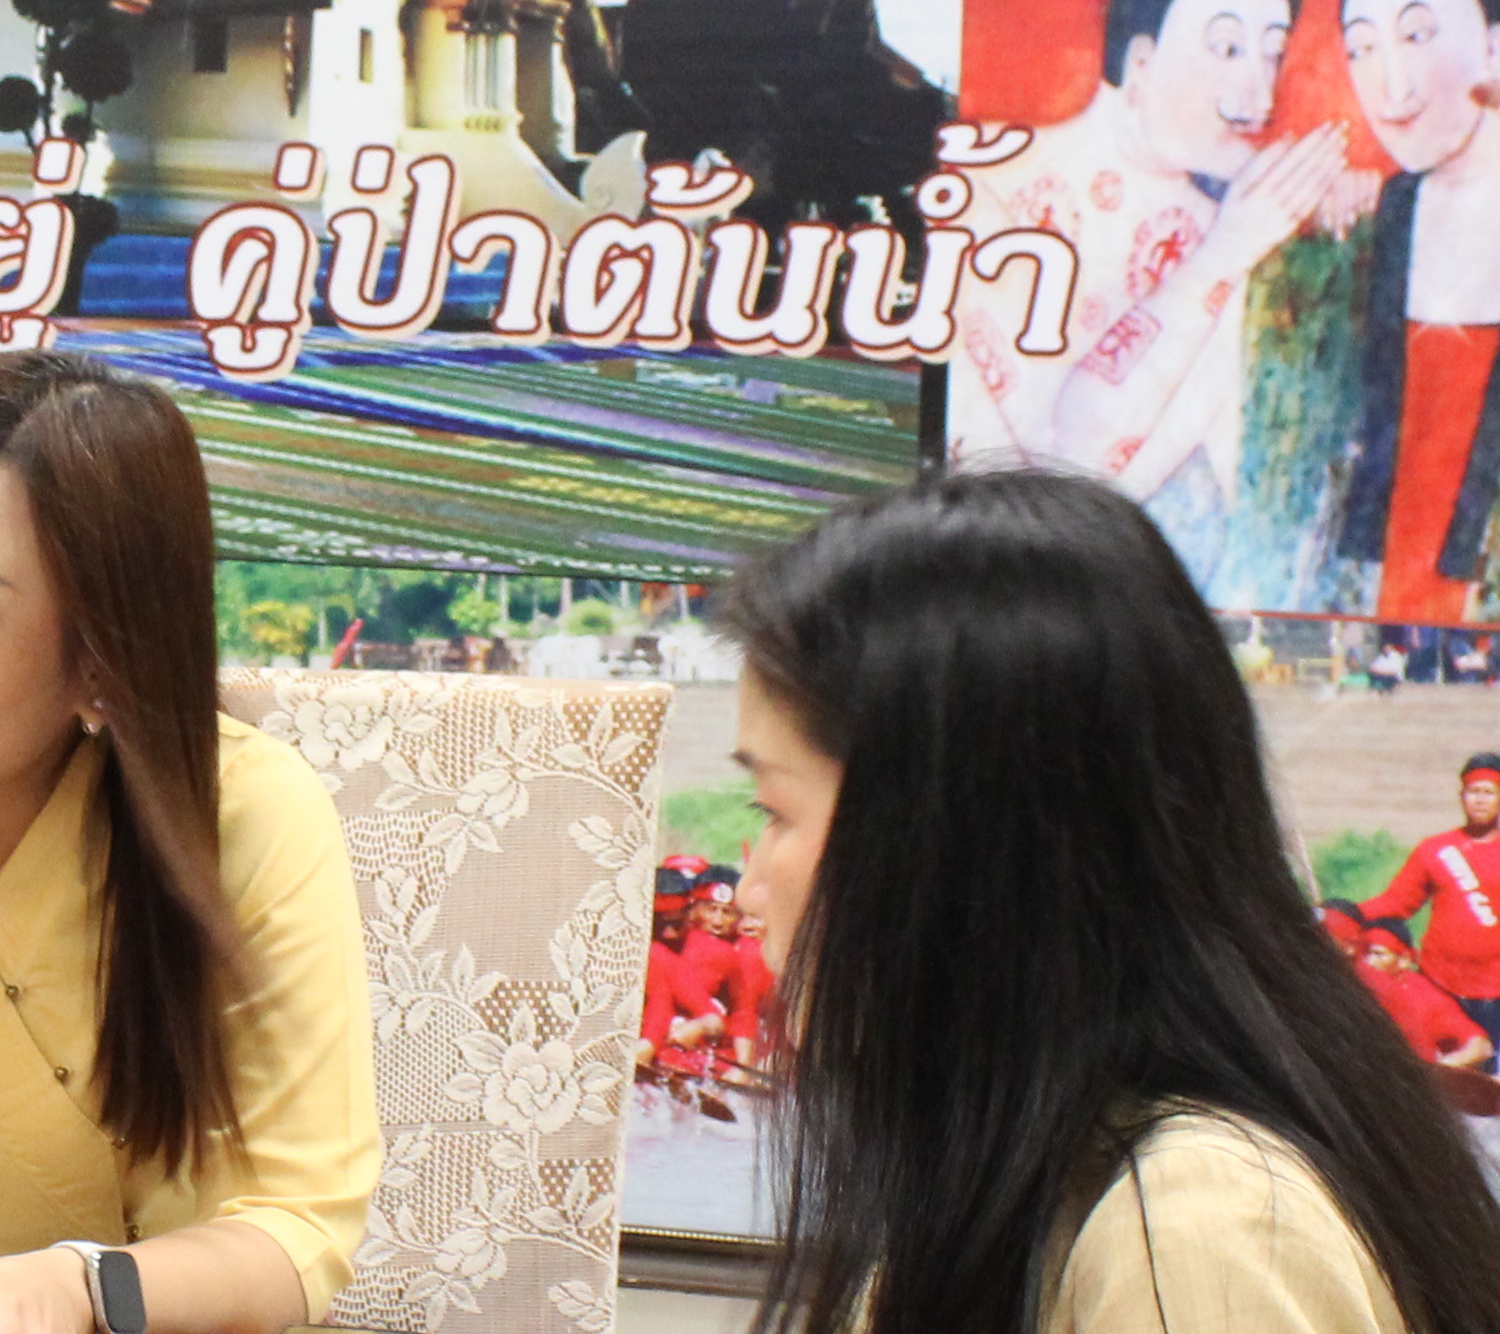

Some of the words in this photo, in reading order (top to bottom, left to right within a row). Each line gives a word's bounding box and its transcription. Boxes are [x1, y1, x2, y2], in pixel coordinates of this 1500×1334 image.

[187, 121, 1081, 381] คู่ป่าต้นน้ำ
